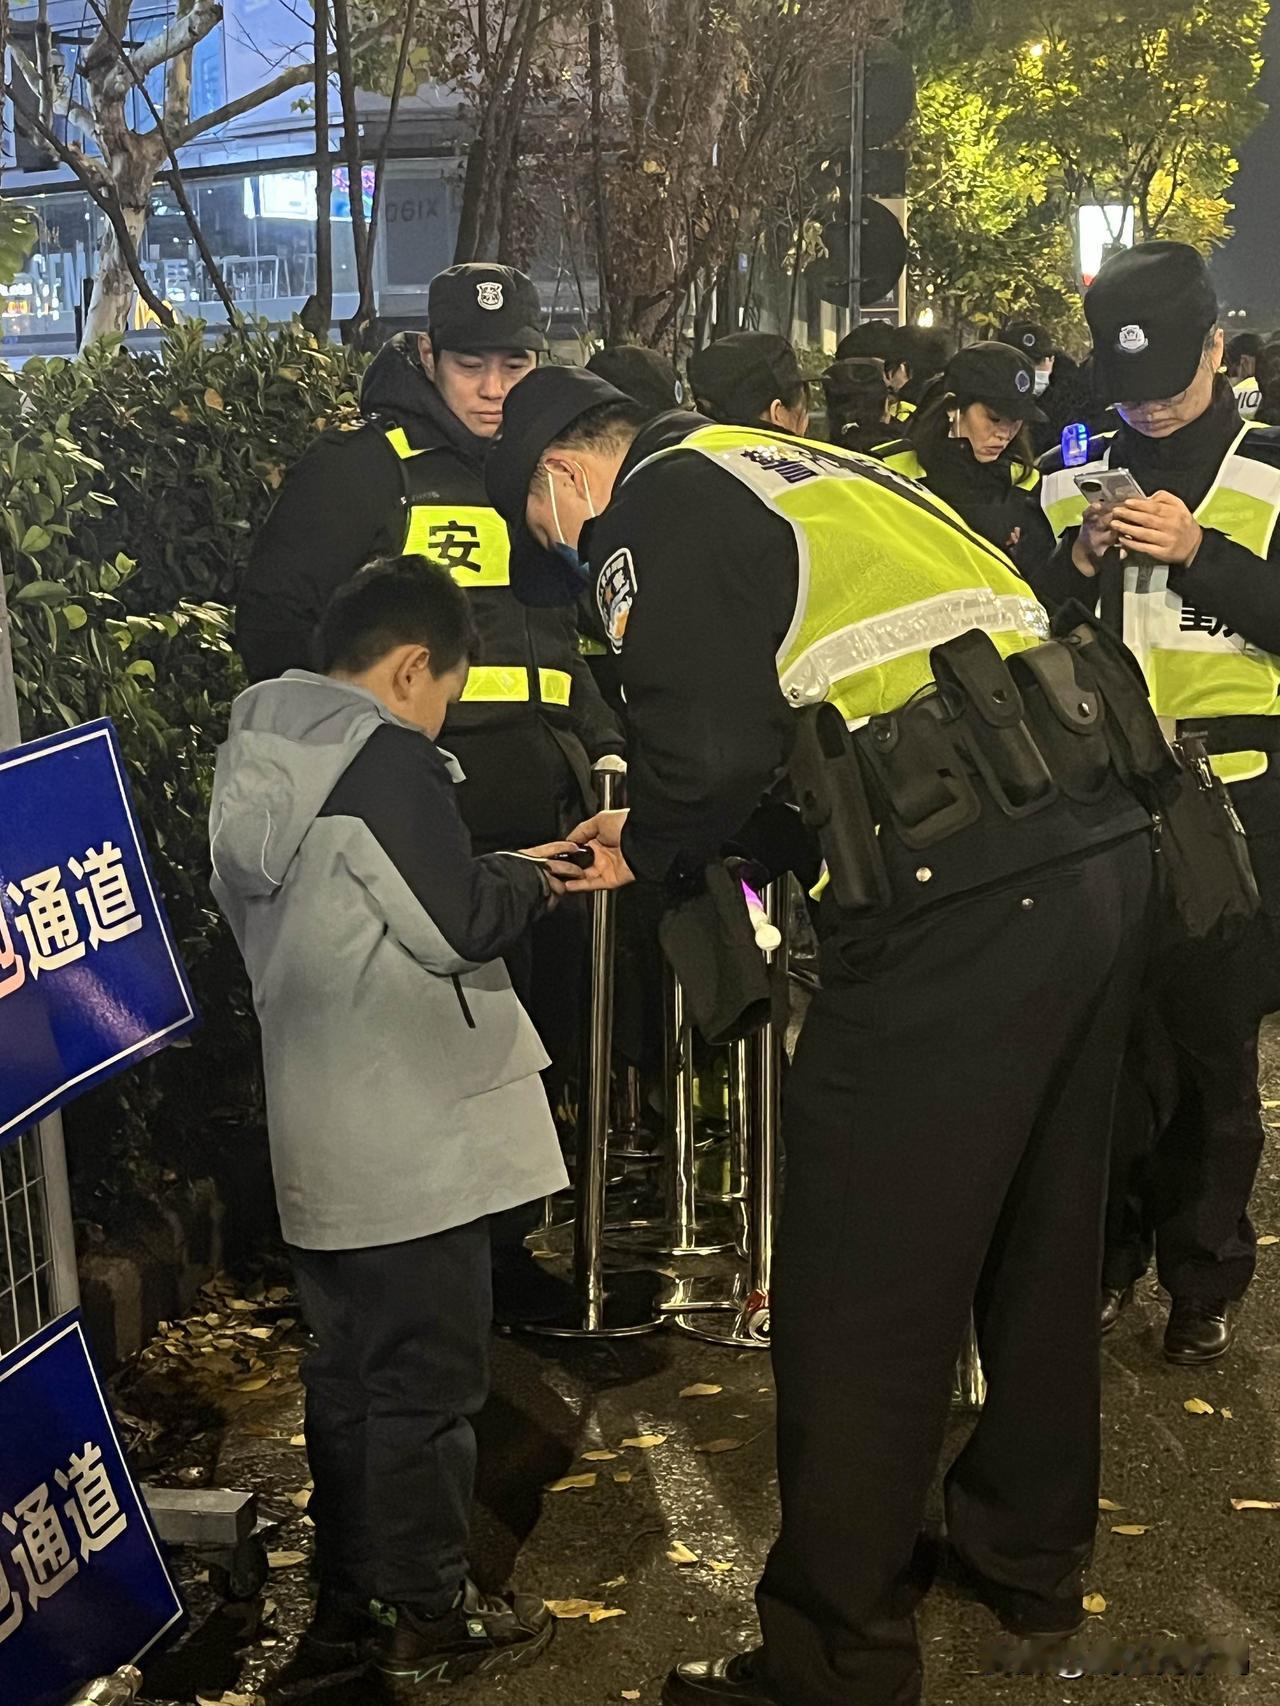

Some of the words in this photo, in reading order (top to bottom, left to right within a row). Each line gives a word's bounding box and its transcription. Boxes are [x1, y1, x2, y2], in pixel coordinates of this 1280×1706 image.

[428, 520, 482, 573] 安
[0, 841, 143, 998] 通道
[0, 1441, 128, 1643] 通道
